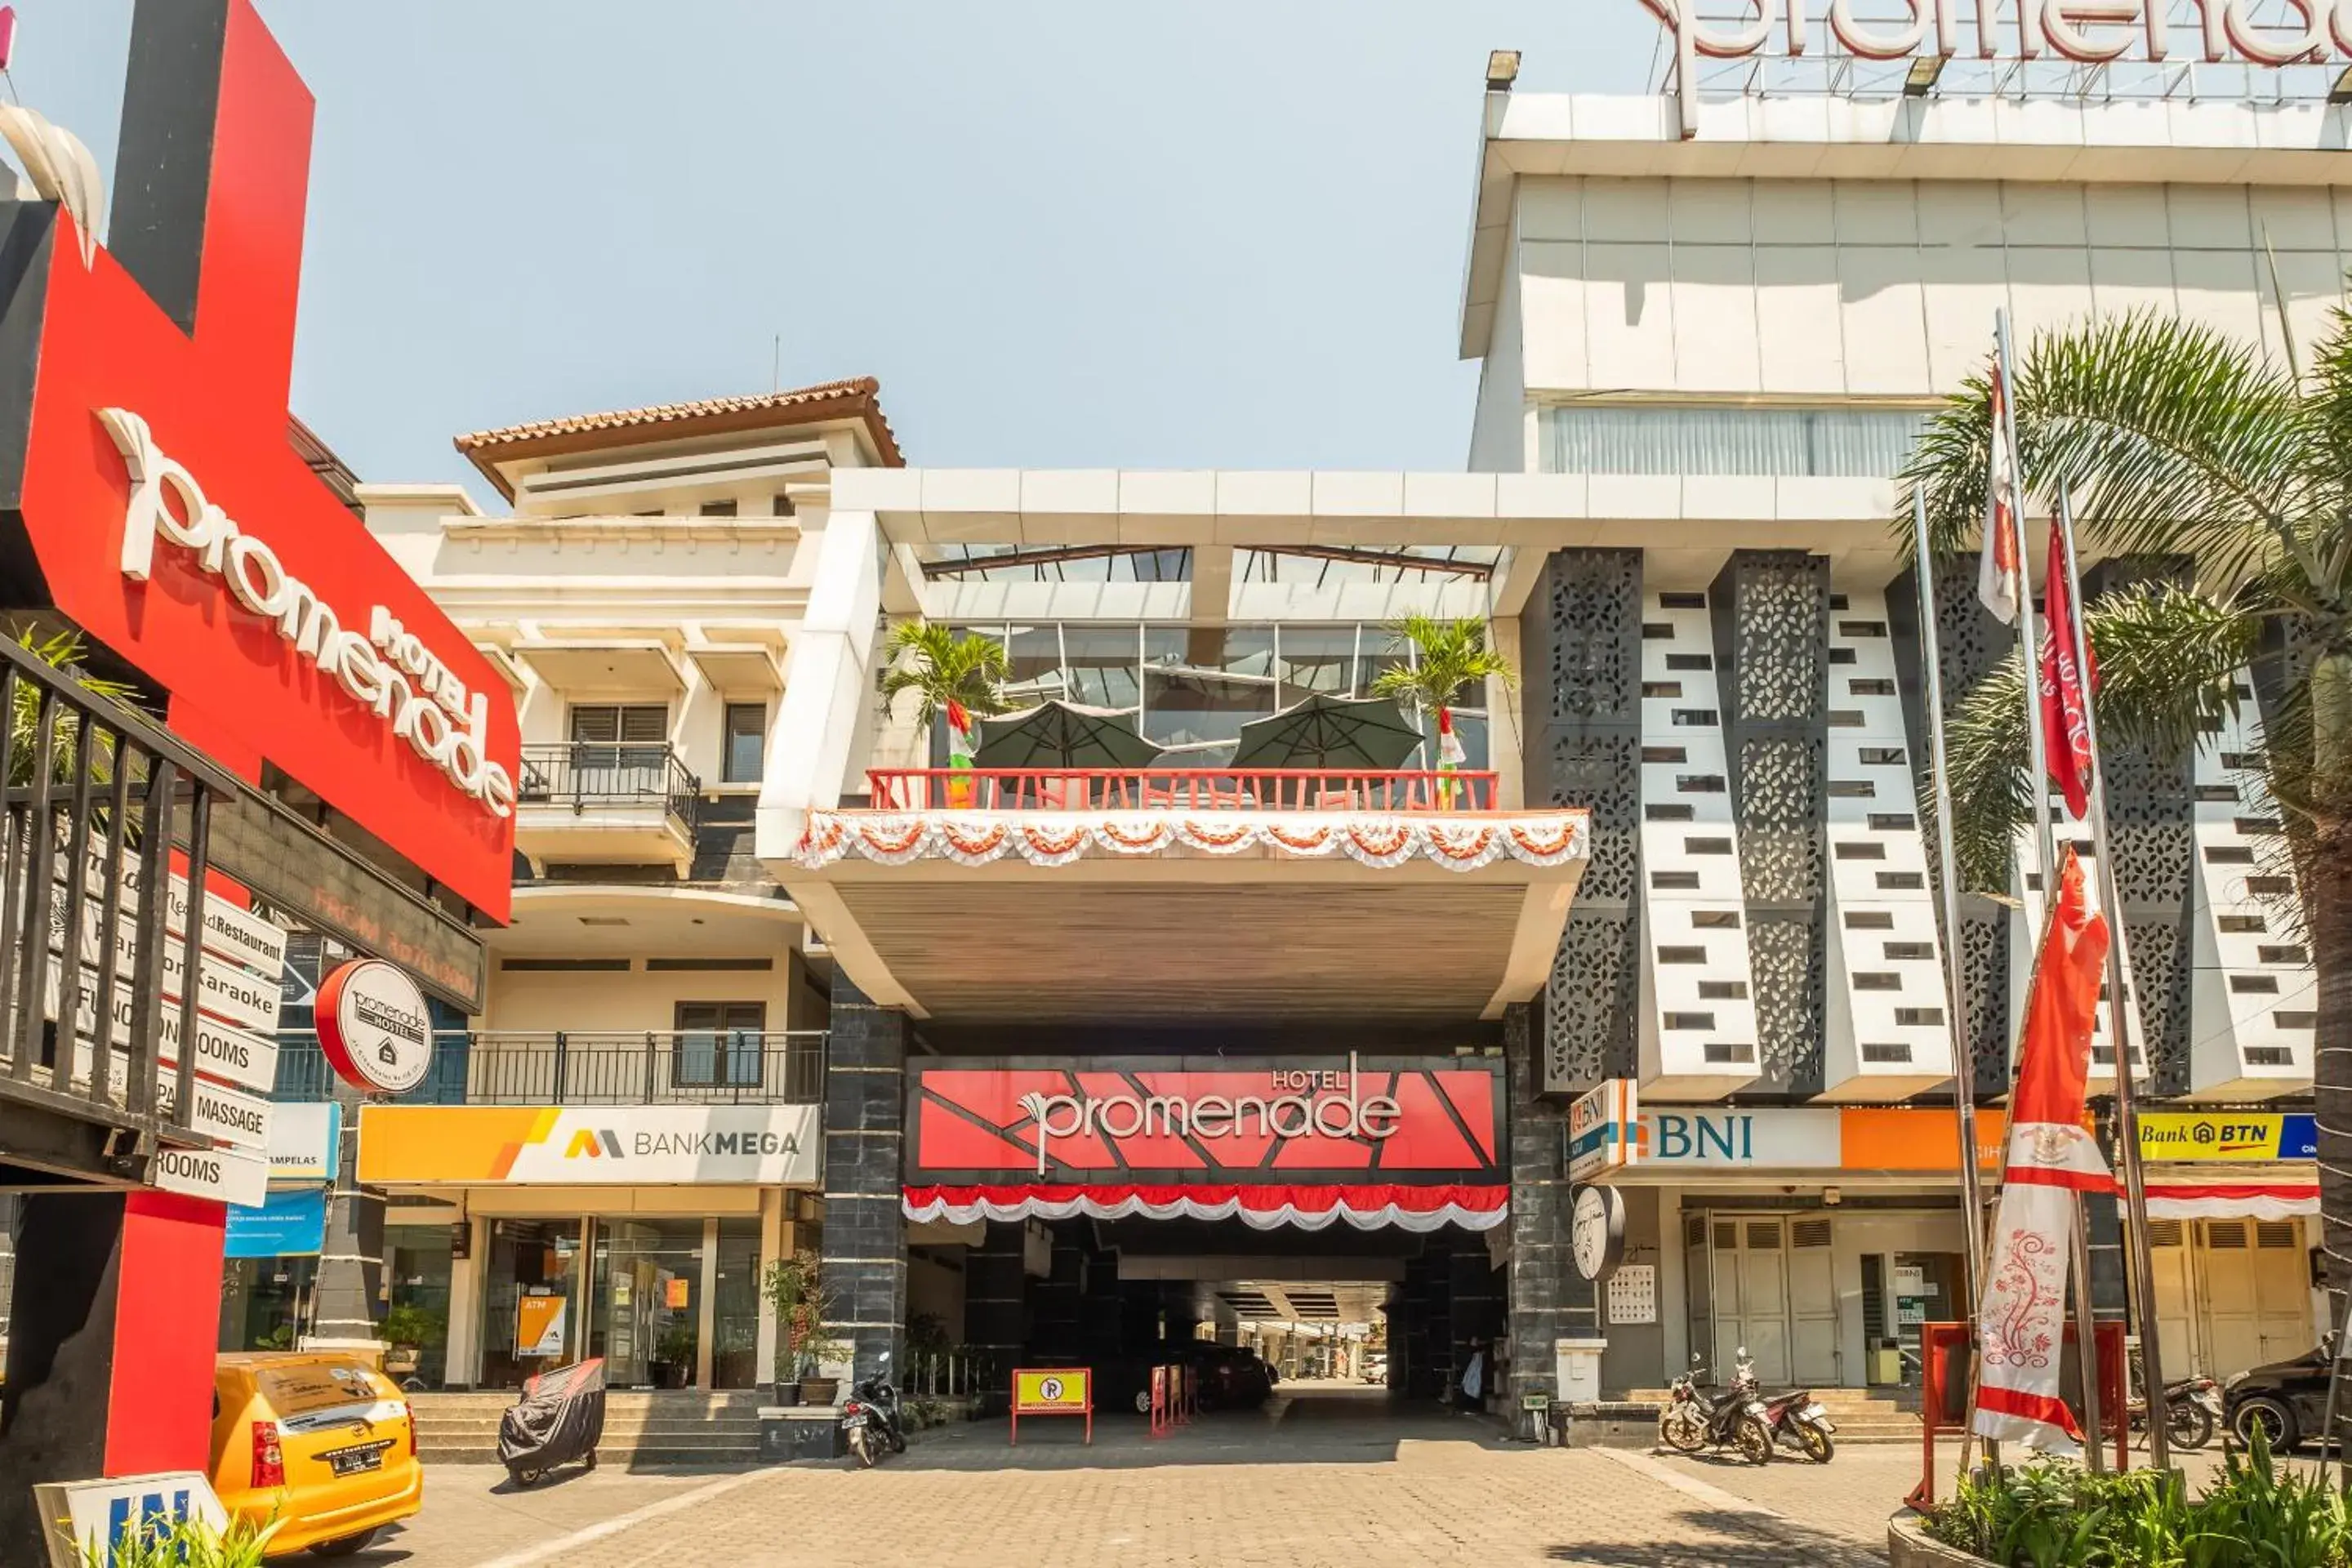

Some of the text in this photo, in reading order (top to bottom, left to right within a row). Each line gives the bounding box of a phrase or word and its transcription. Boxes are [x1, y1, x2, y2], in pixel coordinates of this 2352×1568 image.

[90, 407, 514, 817] promenade
[370, 604, 472, 727] HOTEL
[198, 1032, 249, 1069] OOMS
[1272, 1070, 1346, 1090] HOTEL
[196, 1095, 264, 1135] MASSAGE
[1017, 1050, 1402, 1177] promenade
[2141, 1125, 2268, 1143] Bank BTN
[1656, 1115, 1753, 1160] BNI
